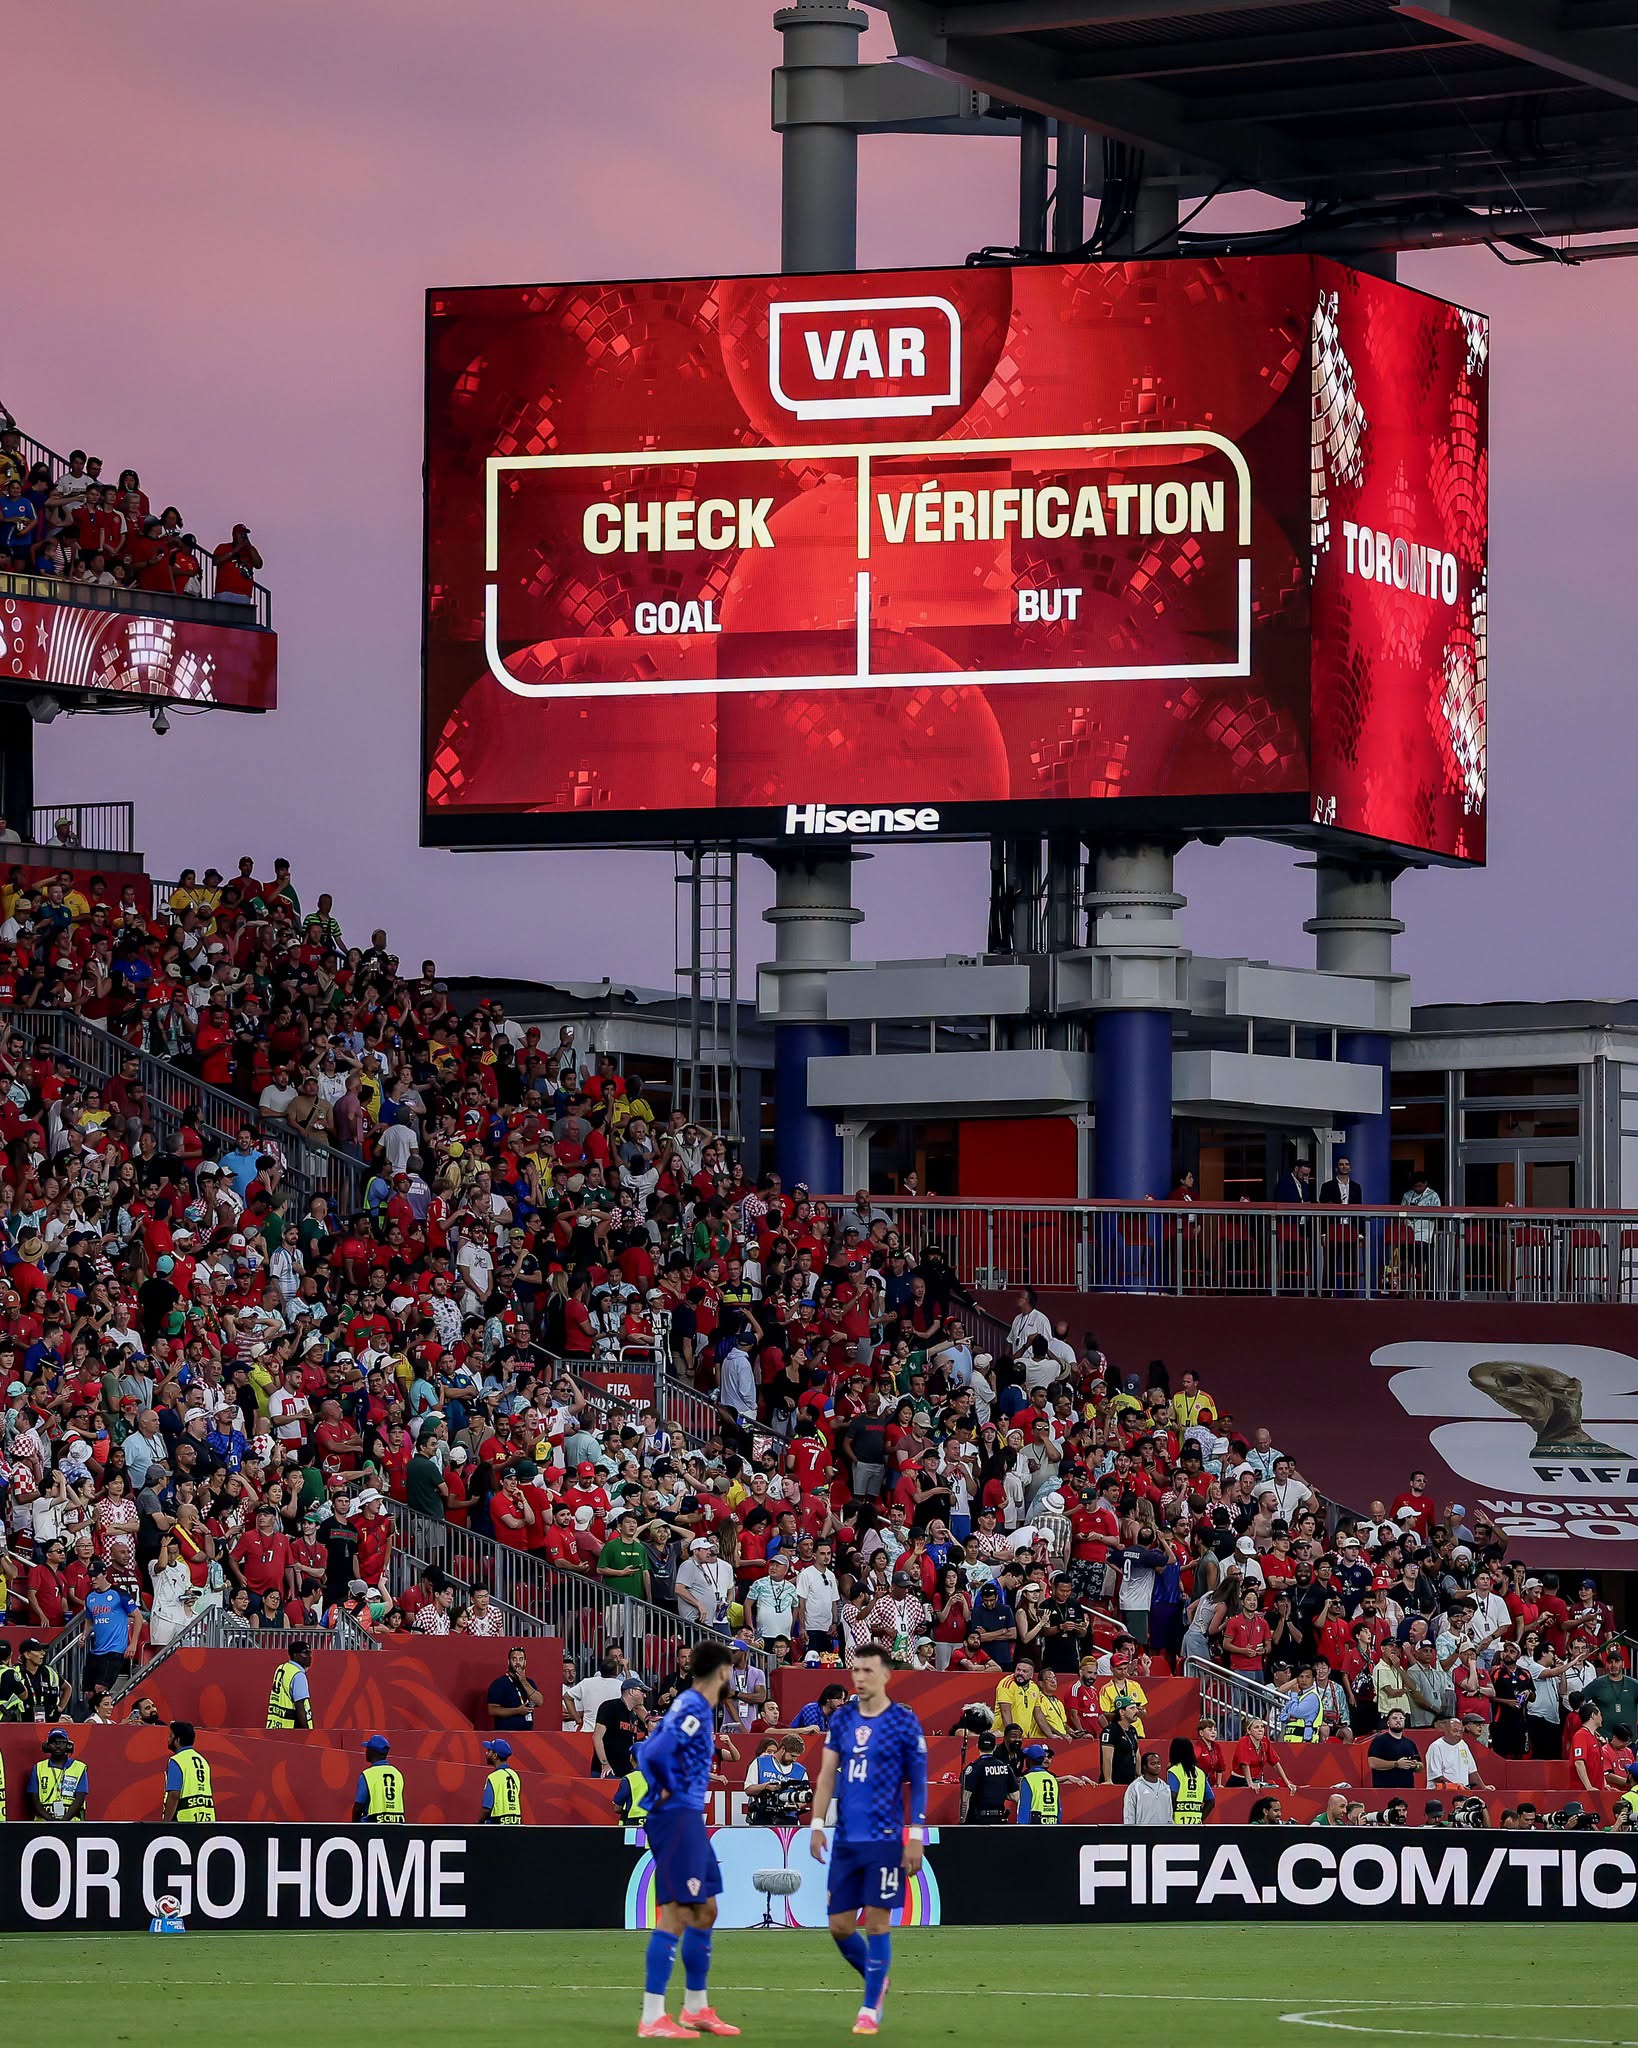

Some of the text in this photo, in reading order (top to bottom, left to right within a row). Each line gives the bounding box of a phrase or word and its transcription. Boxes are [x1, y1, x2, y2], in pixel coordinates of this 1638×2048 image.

[804, 327, 926, 381] VAR
[582, 497, 775, 554] CHECK
[878, 481, 1225, 544] VÉRIFICATION
[1343, 520, 1458, 606] TORONTO
[634, 600, 722, 634] GOAL
[1018, 588, 1082, 622] BUT
[785, 803, 940, 834] Hisense
[607, 1383, 631, 1396] FIFA
[809, 1448, 820, 1471] 7
[267, 1550, 274, 1562] 7
[1123, 1558, 1132, 1582] 9
[763, 1771, 777, 1779] FIFA
[848, 1758, 868, 1783] 14
[985, 1765, 1009, 1776] POLICE
[20, 1836, 467, 1920] OR GO HOME
[880, 1867, 899, 1891] 14
[1079, 1843, 1638, 1909] FIFA.COM/TIC
